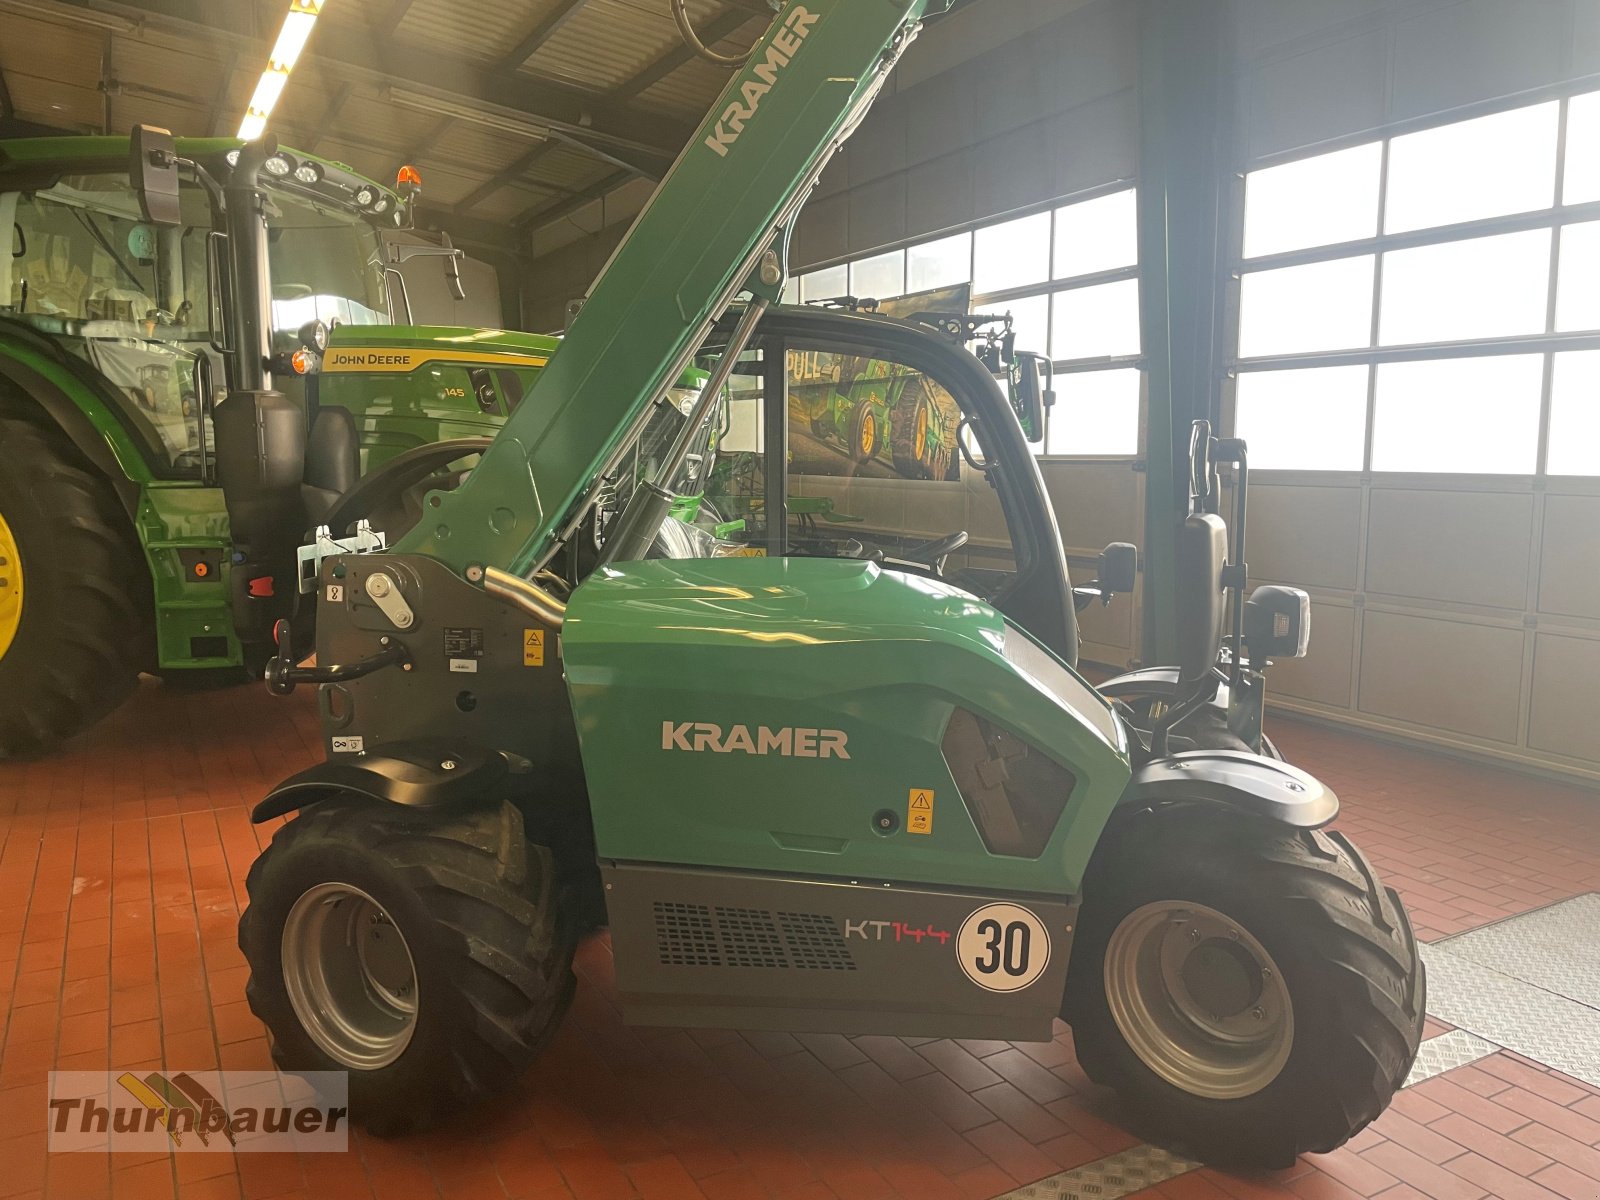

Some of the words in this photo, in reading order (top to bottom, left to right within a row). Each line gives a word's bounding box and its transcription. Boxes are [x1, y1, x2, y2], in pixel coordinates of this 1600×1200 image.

[704, 5, 821, 157] KRAMER
[332, 354, 365, 365] JOHN
[368, 354, 410, 365] DEERE
[445, 387, 465, 397] 145
[662, 720, 851, 760] KRAMER
[845, 918, 950, 945] KT144
[975, 918, 1031, 977] 30
